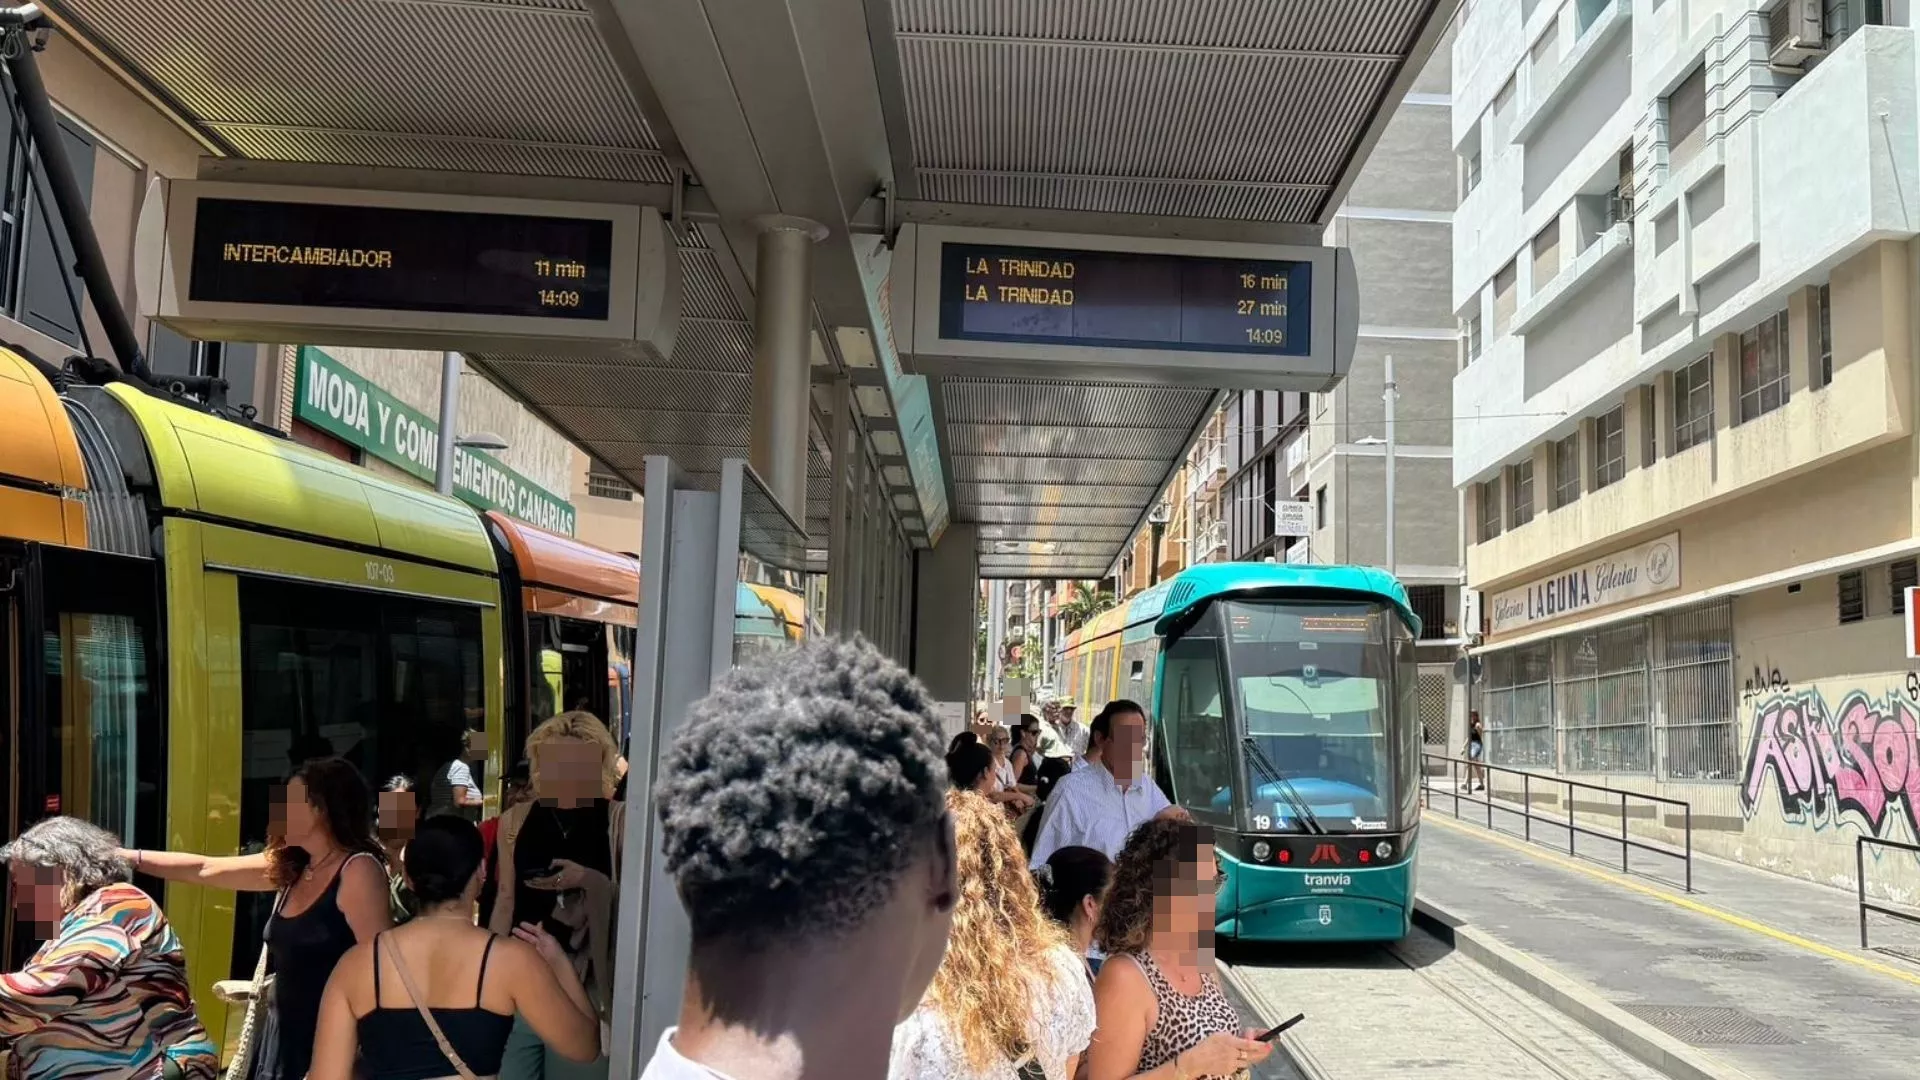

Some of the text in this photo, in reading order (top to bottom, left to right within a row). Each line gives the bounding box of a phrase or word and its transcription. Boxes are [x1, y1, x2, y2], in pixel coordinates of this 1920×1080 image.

[223, 243, 586, 278] INTERCAMBIADOR 11 min
[966, 257, 1288, 290] LA TRINIDAD 16 min
[538, 289, 580, 307] 14:09
[965, 284, 1288, 316] LA TRINIDAD 27 min
[1245, 328, 1284, 345] 14:09
[307, 359, 573, 536] MODA Y COMEMENTOS CANARIAS
[1527, 568, 1590, 620] LAGUNA
[1253, 814, 1271, 830] 19
